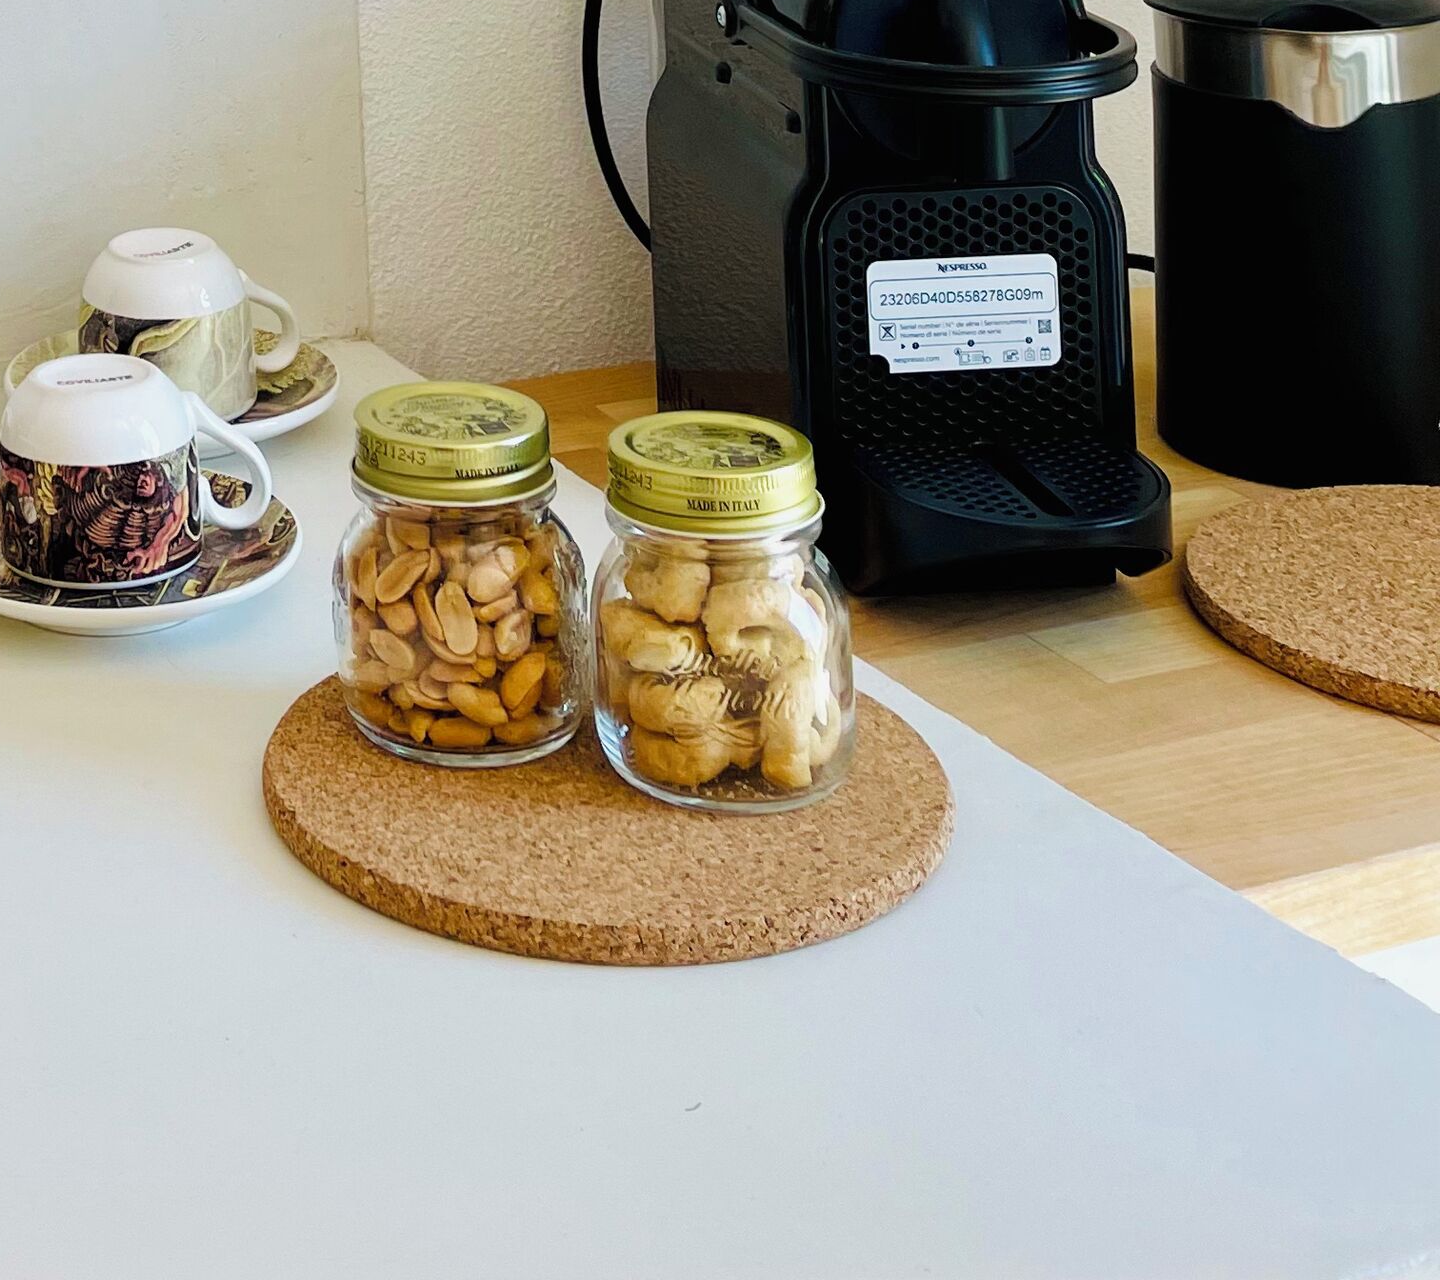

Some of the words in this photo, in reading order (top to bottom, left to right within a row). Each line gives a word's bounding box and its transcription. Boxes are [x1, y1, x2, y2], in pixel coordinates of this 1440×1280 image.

[936, 262, 988, 273] NESPRESSO
[686, 498, 717, 512] MADE
[718, 500, 731, 512] IN
[731, 499, 760, 512] ITALY
